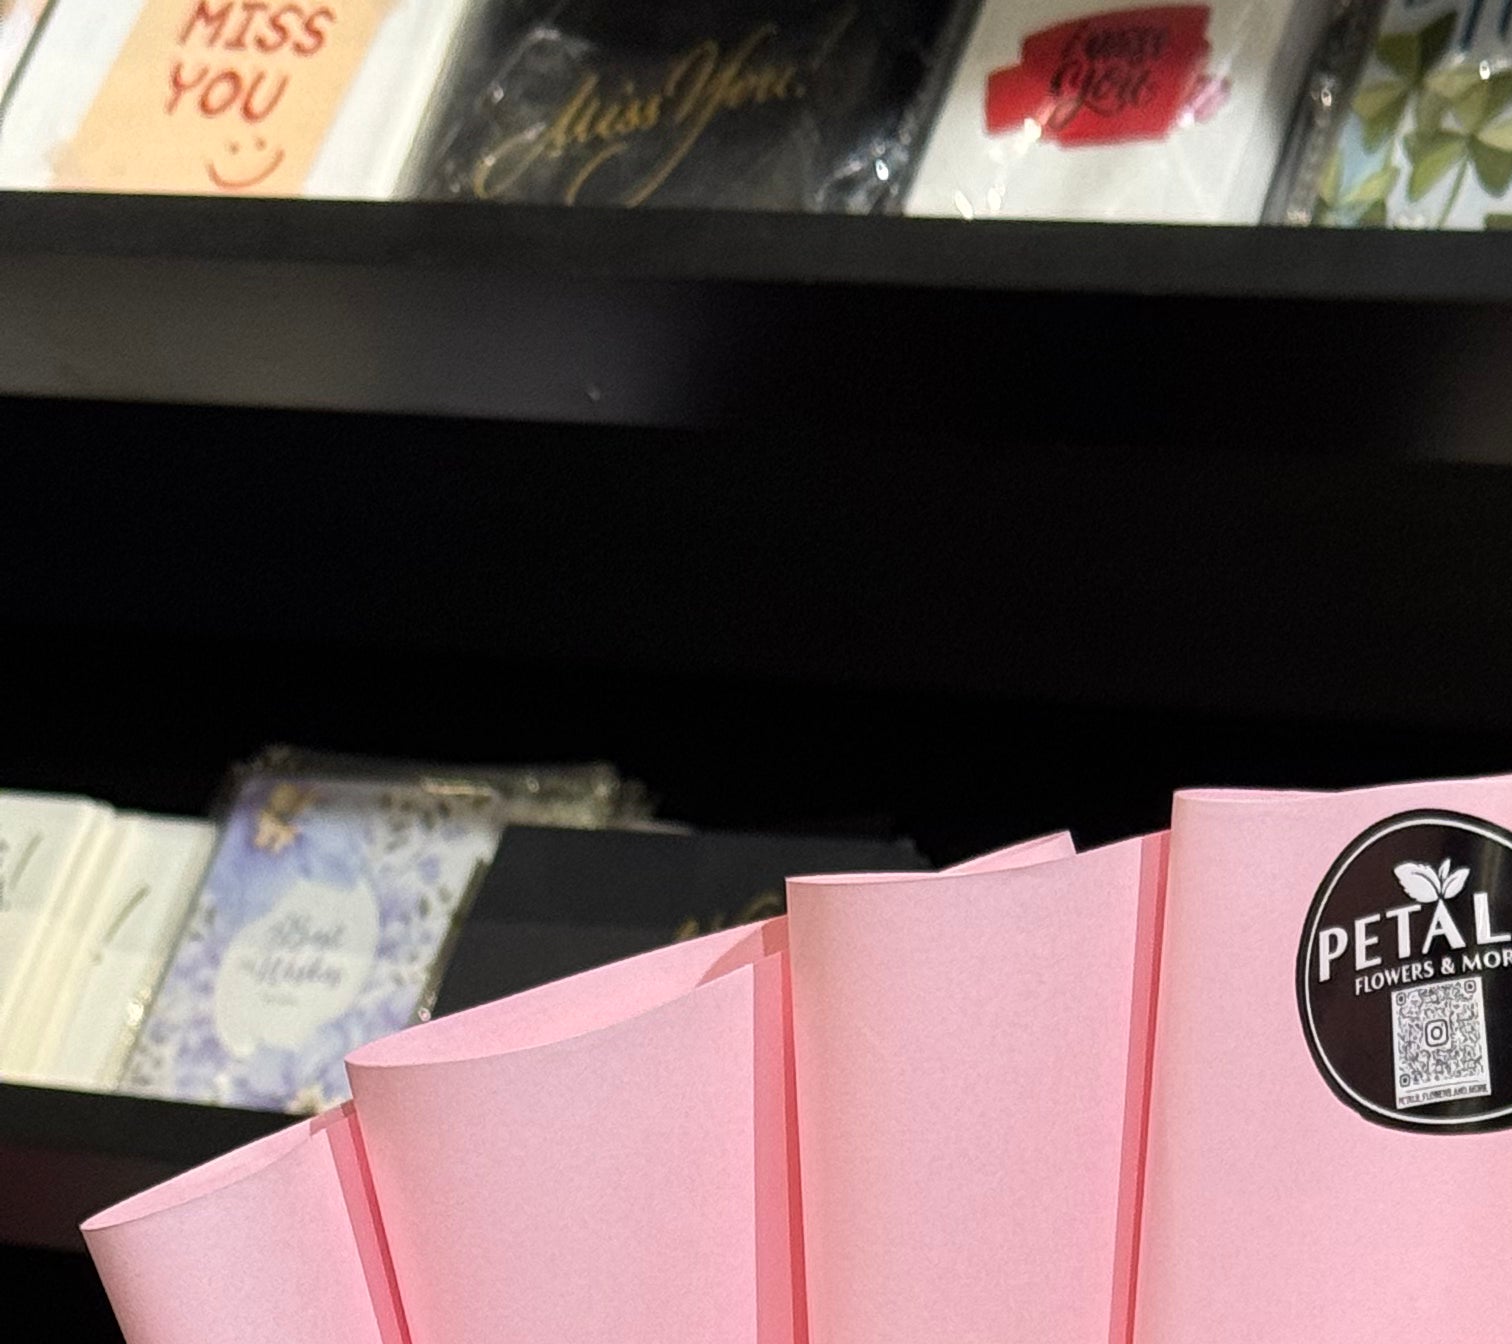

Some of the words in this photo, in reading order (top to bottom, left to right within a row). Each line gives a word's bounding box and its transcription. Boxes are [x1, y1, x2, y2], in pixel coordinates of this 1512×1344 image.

[179, 0, 337, 57] MISS
[163, 61, 290, 125] YOU
[1354, 959, 1435, 996] FLOWERS
[1440, 957, 1456, 975] &
